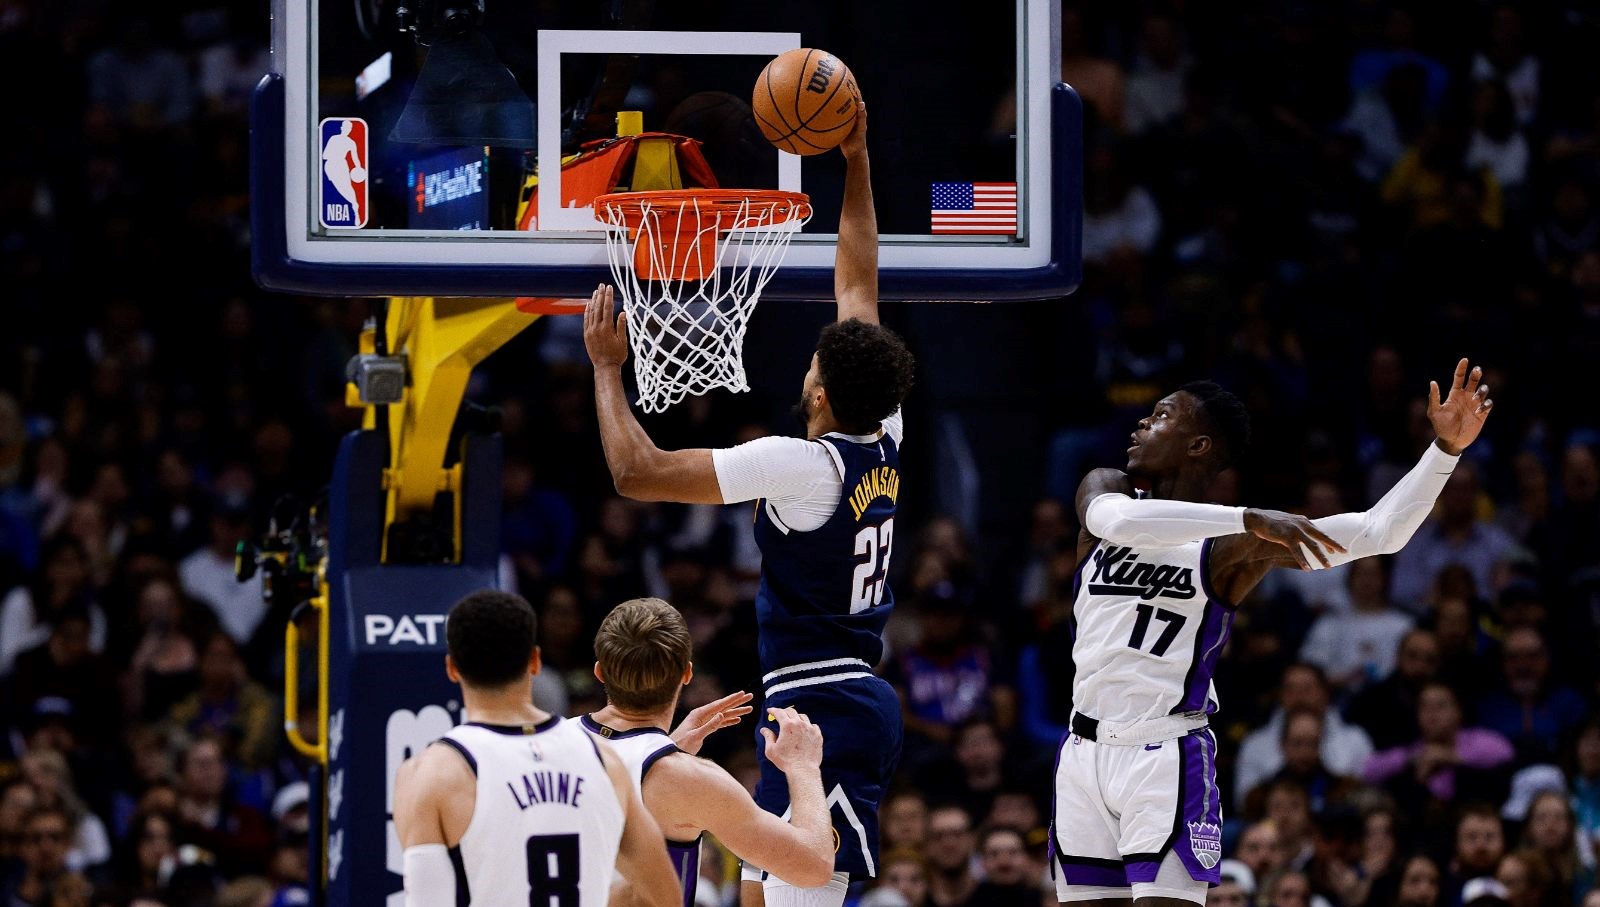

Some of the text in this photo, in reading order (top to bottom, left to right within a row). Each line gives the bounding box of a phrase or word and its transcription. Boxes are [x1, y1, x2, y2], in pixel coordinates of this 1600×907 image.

[326, 203, 350, 221] NBA
[848, 466, 900, 522] JOHNSON
[849, 516, 895, 615] 23
[1088, 545, 1197, 600] Kings
[364, 614, 449, 645] PAT
[1127, 603, 1188, 657] 17
[507, 771, 586, 811] LAVINE
[526, 833, 580, 907] 8
[1192, 839, 1221, 851] KINGS
